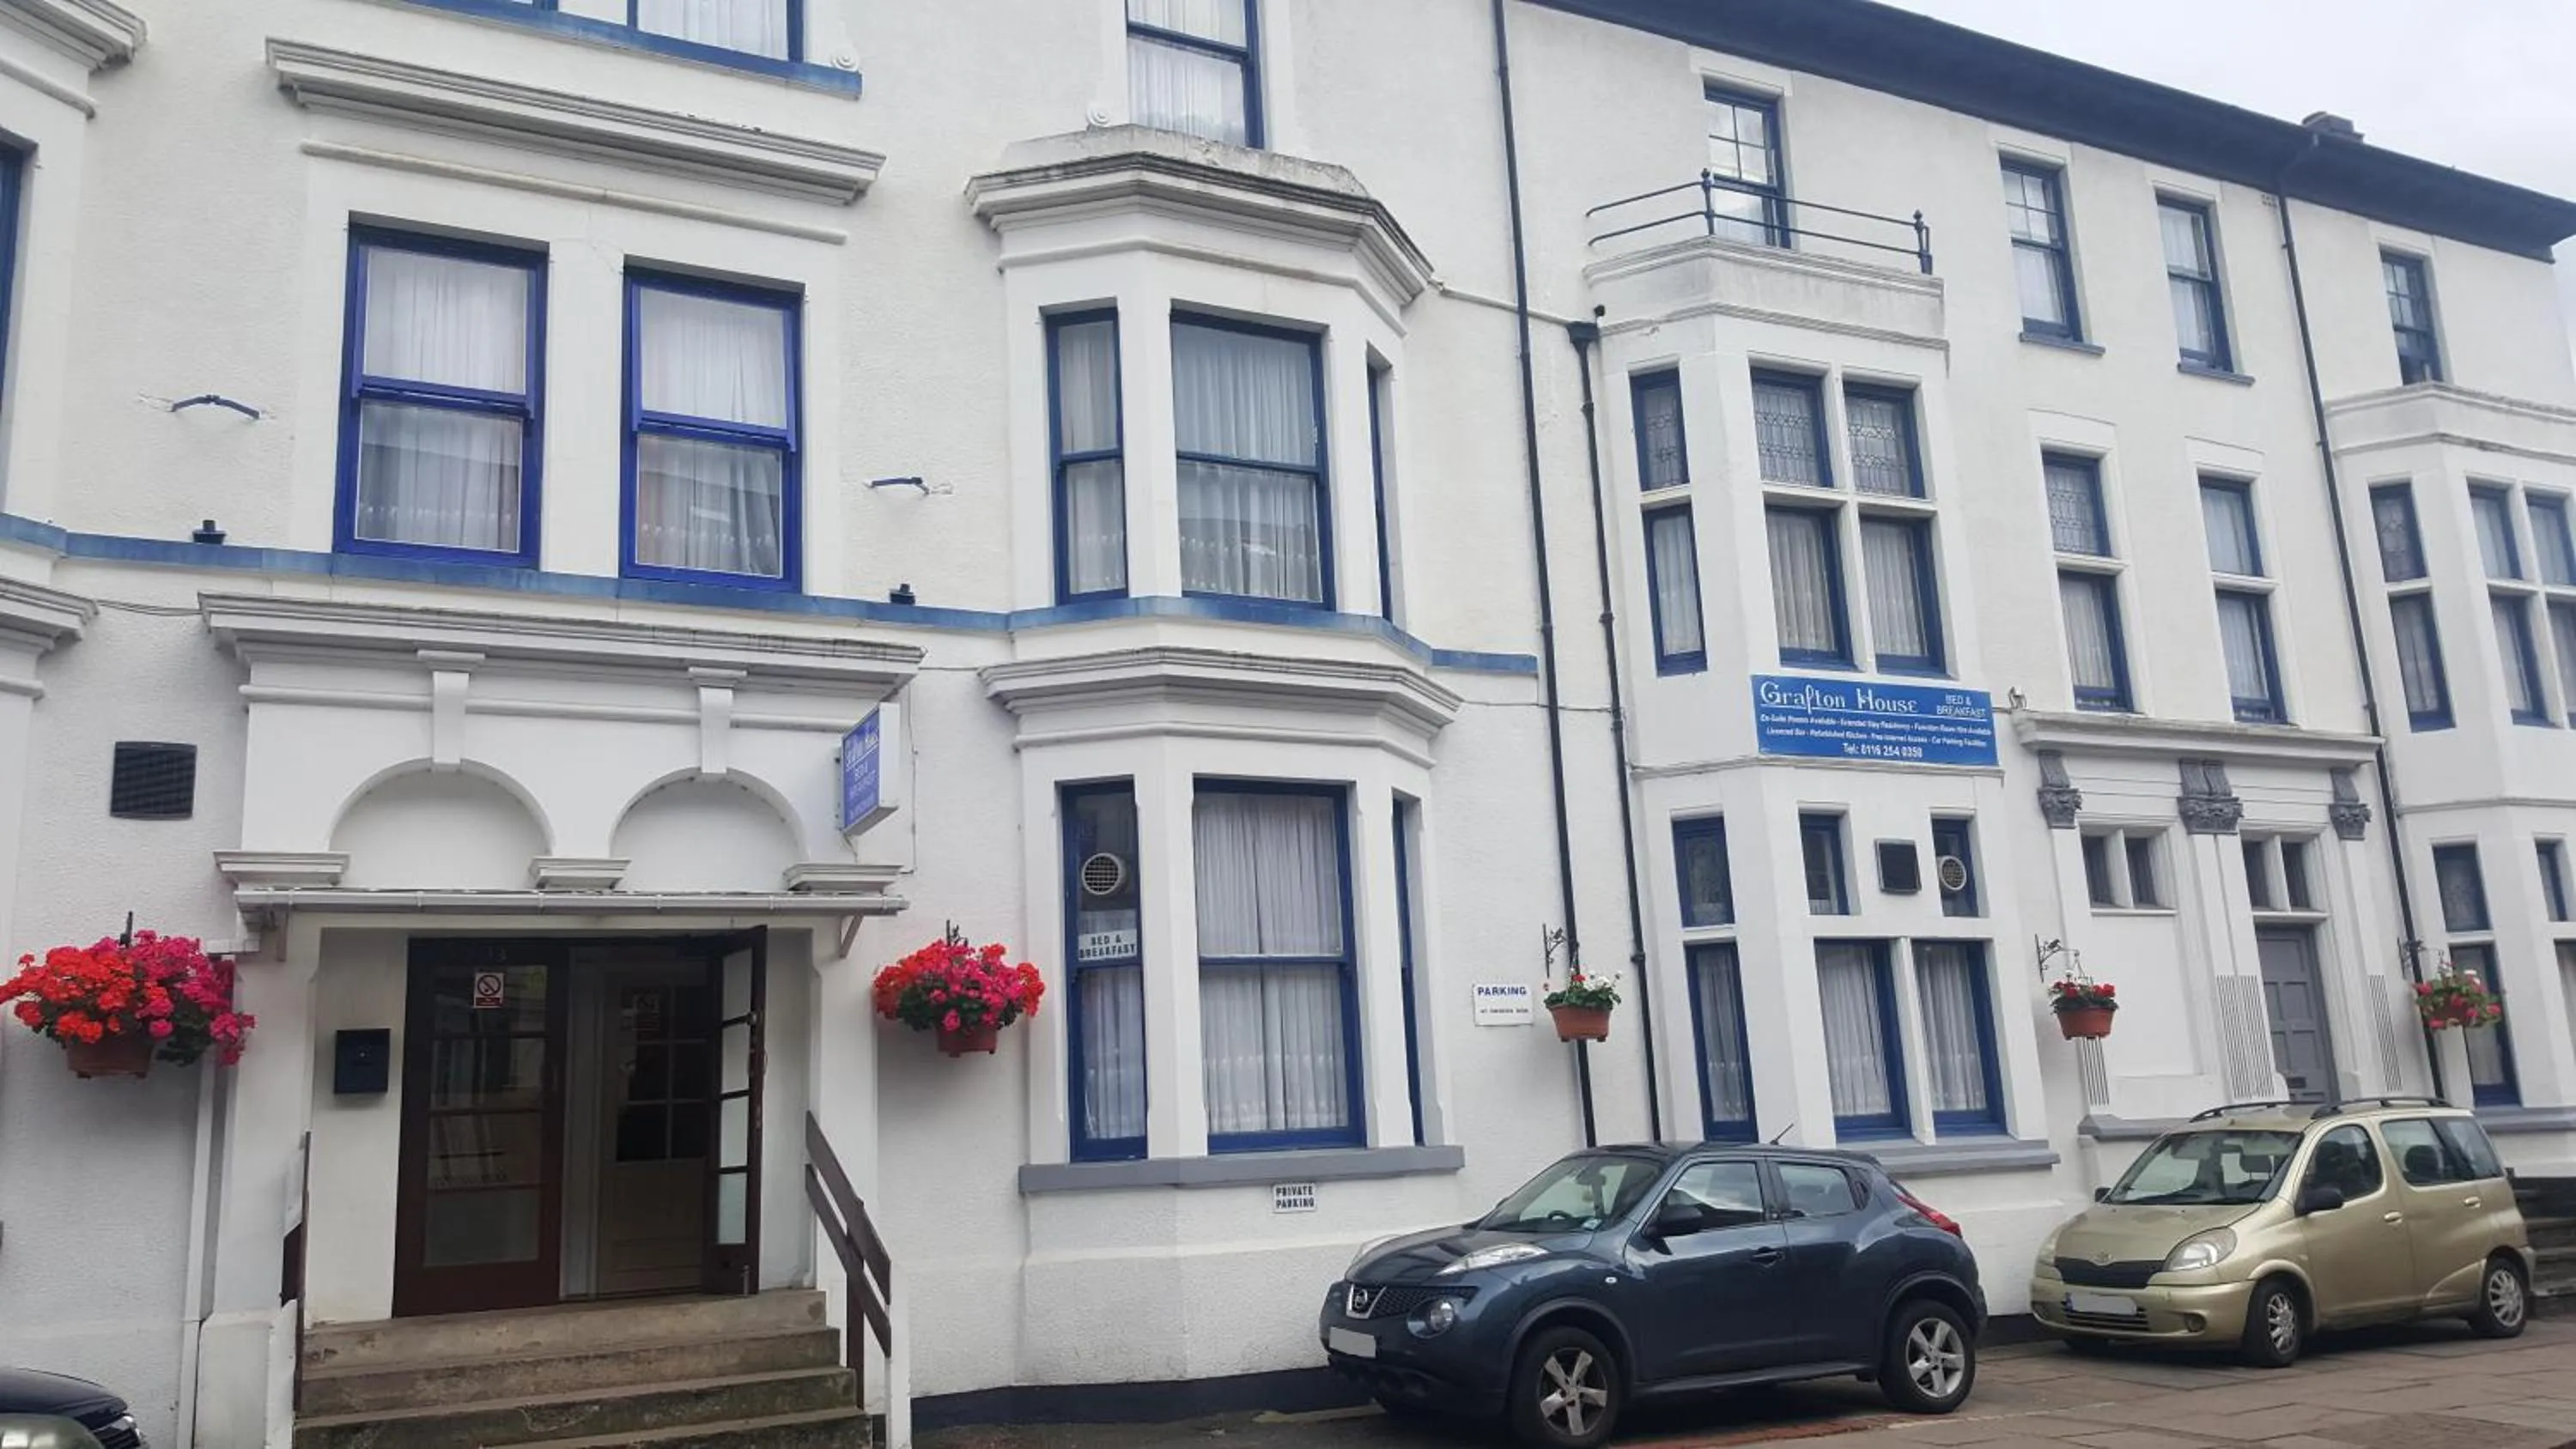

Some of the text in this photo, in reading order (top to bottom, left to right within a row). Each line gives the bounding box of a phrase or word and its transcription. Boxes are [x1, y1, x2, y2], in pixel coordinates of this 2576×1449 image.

[1760, 681, 1918, 714] Grafton House
[1946, 694, 1973, 706] BED &
[1936, 705, 1985, 718] BREAKFAST
[1091, 935, 1110, 946] BED
[1079, 943, 1135, 959] BREAKFAST
[1477, 986, 1527, 996] PARKING
[1276, 1185, 1313, 1197] PRIVATE
[1276, 1197, 1315, 1209] PARKING
